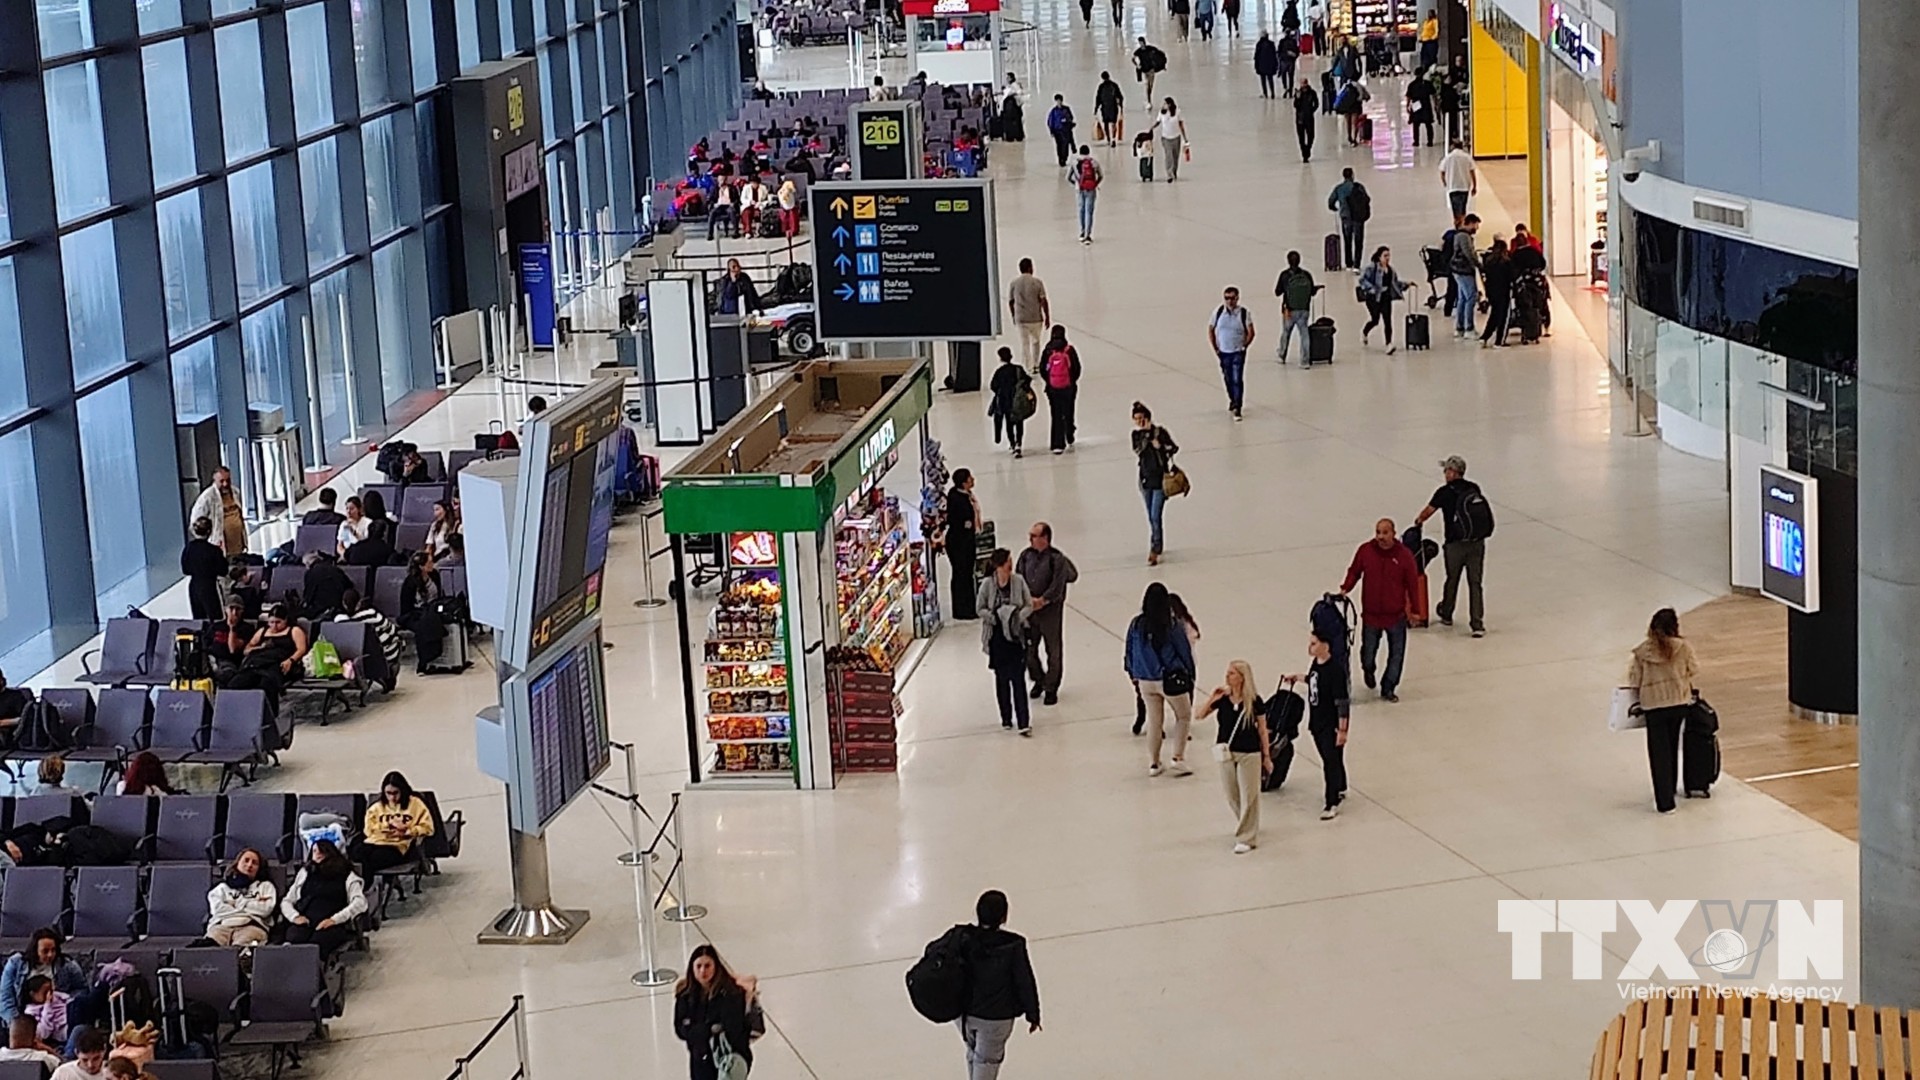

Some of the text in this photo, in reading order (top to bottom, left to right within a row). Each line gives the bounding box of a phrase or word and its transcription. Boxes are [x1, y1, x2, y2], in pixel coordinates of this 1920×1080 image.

[865, 124, 897, 140] 216
[878, 195, 909, 204] Puertas
[880, 223, 919, 232] Comercio
[882, 251, 935, 260] Restaurantes
[860, 442, 871, 476] LA
